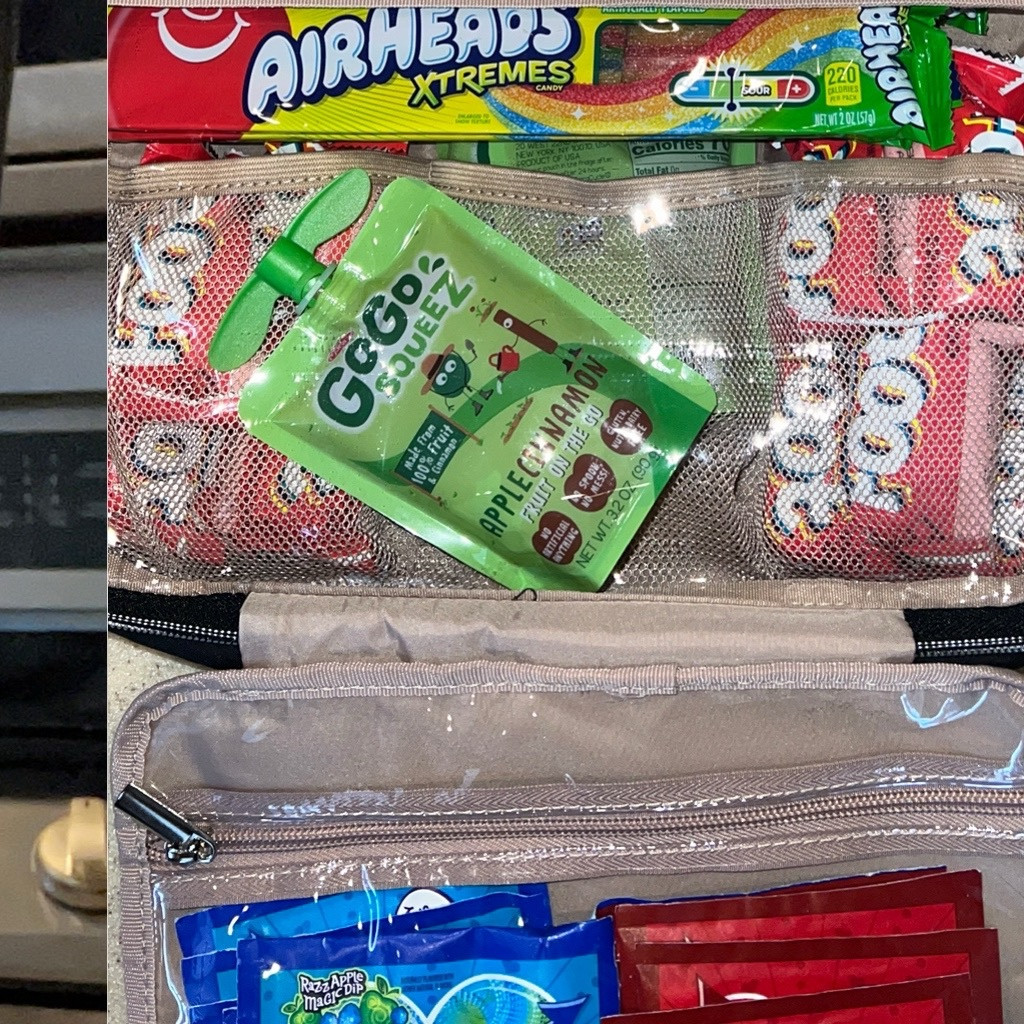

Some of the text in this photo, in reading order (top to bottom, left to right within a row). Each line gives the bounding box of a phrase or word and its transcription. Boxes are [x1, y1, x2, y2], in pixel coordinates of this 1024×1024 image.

[247, 7, 573, 118] AIRHEADS
[411, 60, 571, 106] XTREMES
[827, 66, 856, 85] 220
[743, 86, 771, 96] SOUR
[828, 86, 859, 94] CALORIES
[842, 94, 857, 102] PACK
[839, 112, 844, 125] 2
[845, 112, 856, 125] OZ
[857, 109, 876, 126] (57g)
[635, 166, 654, 176] Total
[656, 166, 669, 174] Fat
[404, 446, 422, 470] Made
[520, 477, 556, 524] FRUIT
[549, 454, 571, 478] ON
[563, 426, 590, 454] THE
[479, 471, 533, 538] APPLE
[540, 527, 552, 541] NO
[576, 541, 597, 569] NET
[618, 480, 637, 501] OZ
